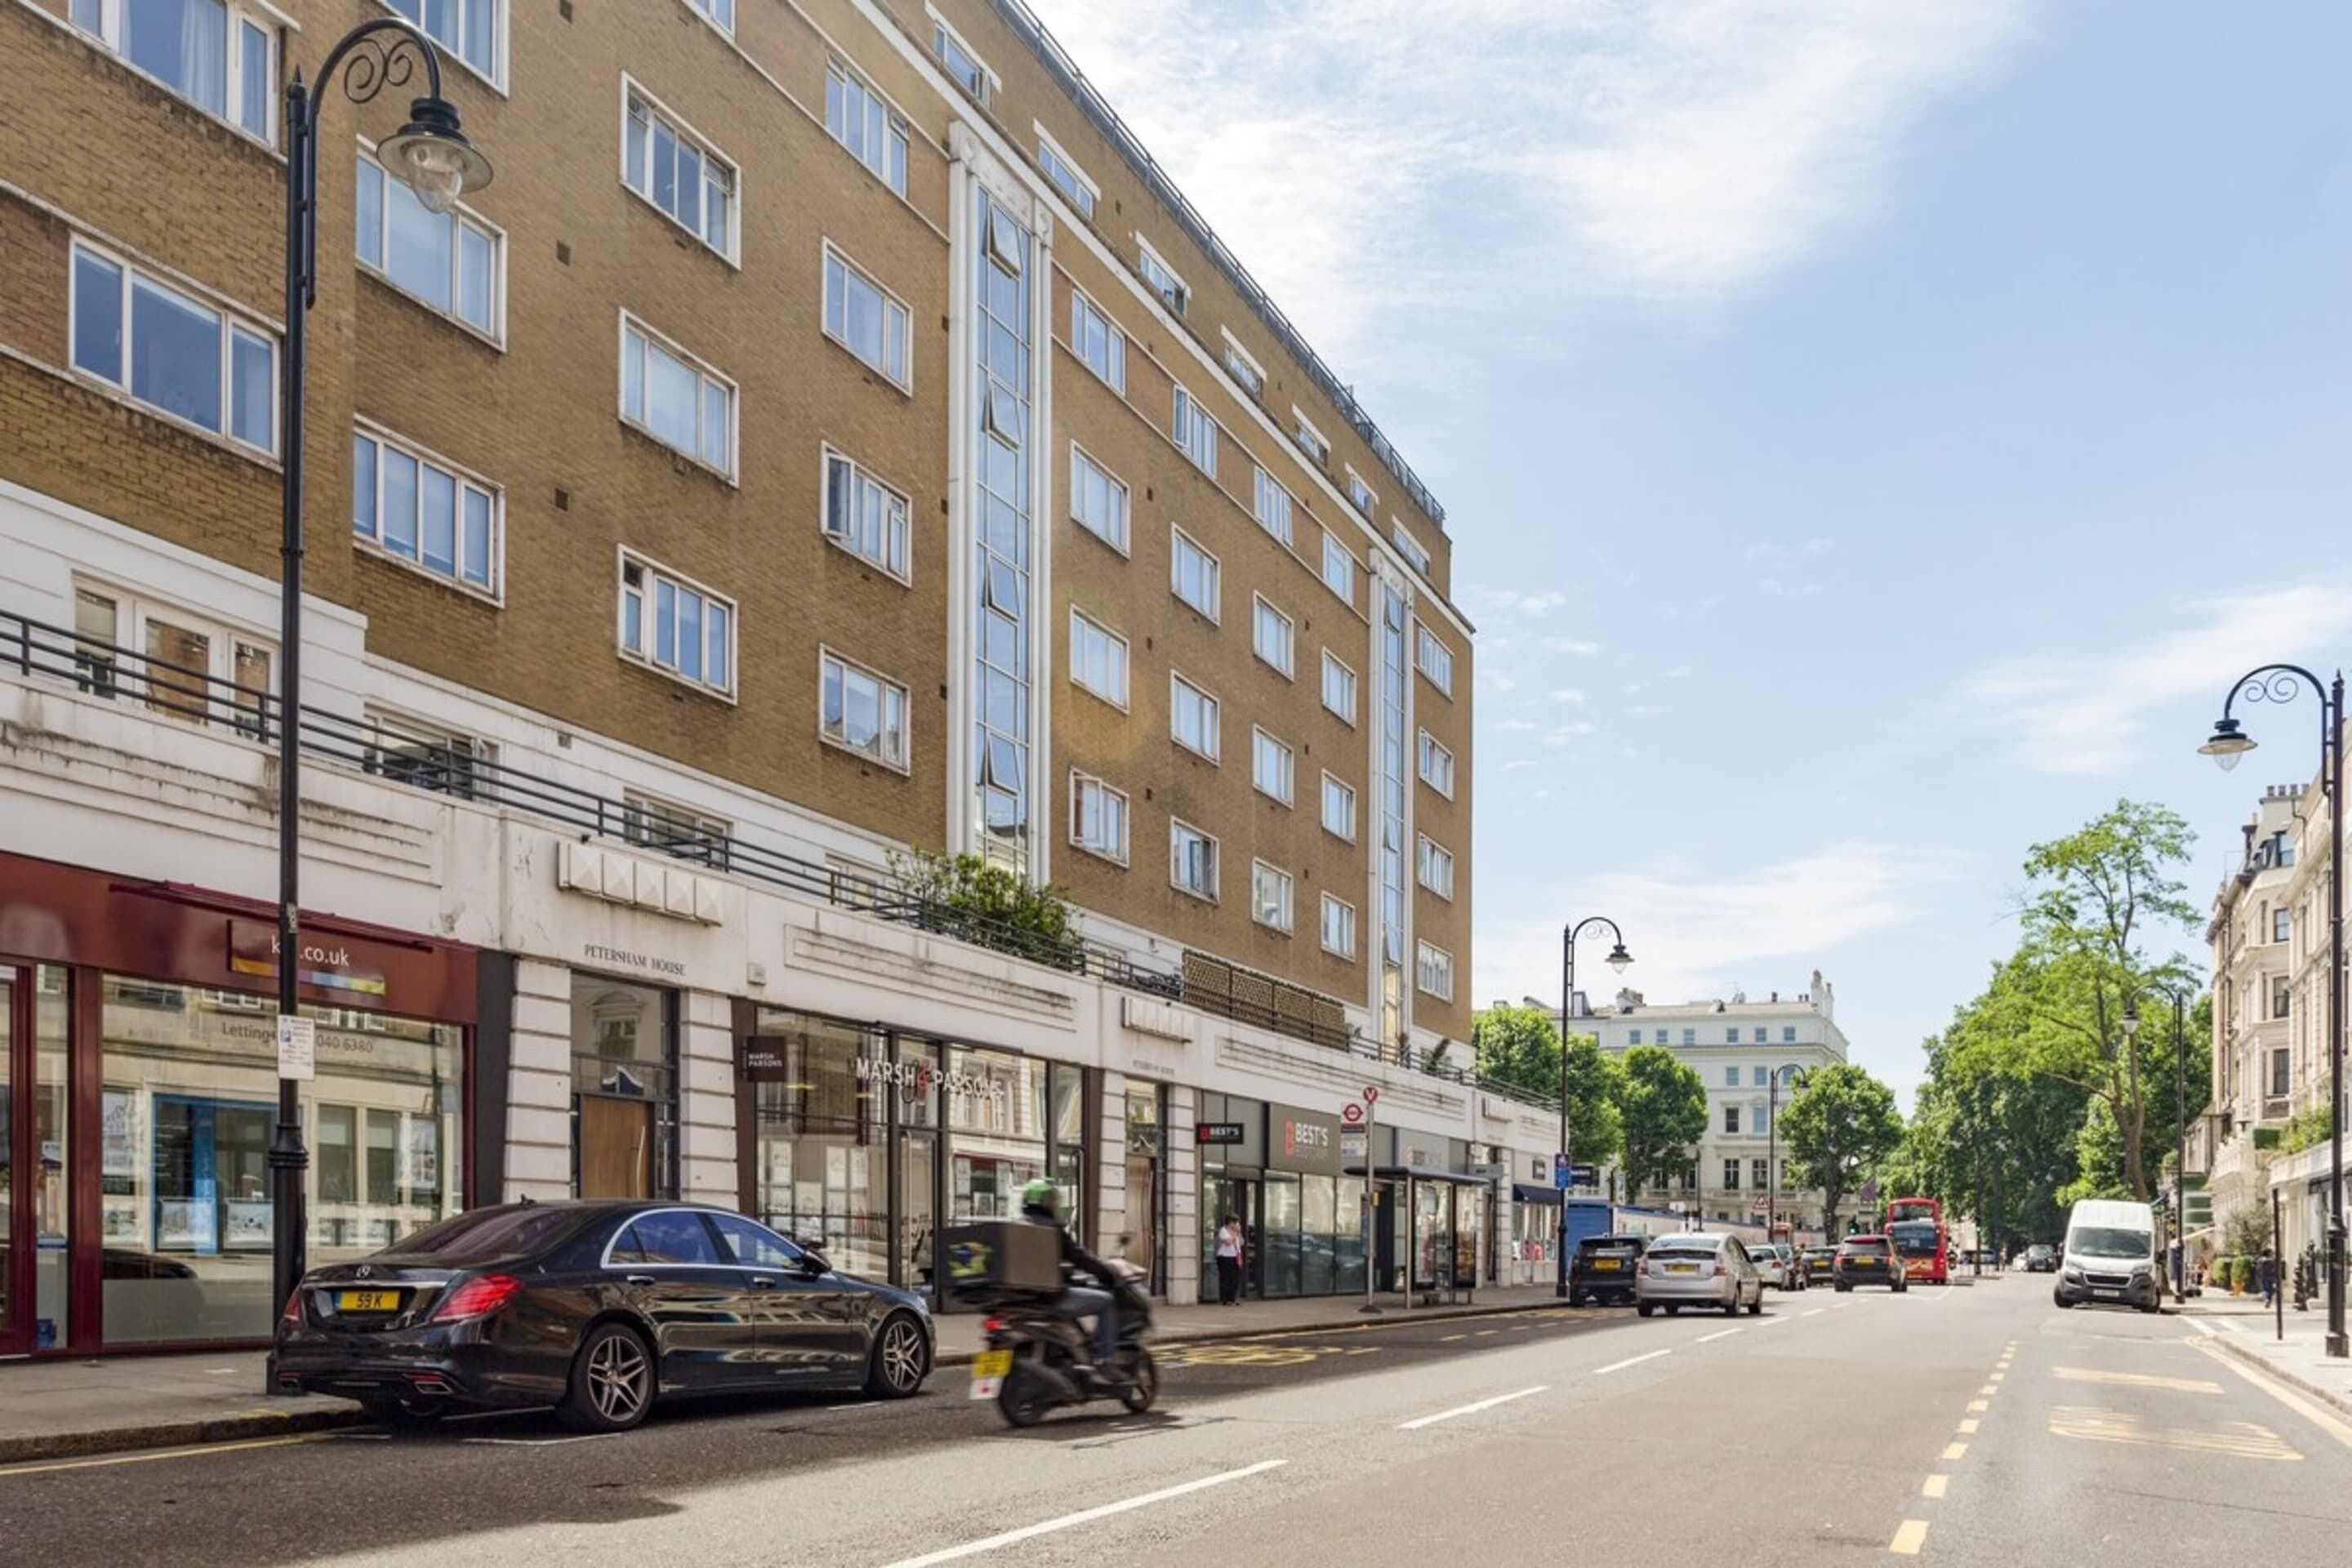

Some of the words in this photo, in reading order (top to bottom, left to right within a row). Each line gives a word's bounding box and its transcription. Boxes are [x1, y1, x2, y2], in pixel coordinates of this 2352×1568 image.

[271, 934, 350, 966] k.co.uk
[585, 944, 647, 968] PETERSHAM
[651, 957, 686, 976] HOUSE
[856, 1058, 915, 1089] MARSH
[1209, 1126, 1239, 1136] BEST'S
[1295, 1122, 1329, 1147] BEST'S
